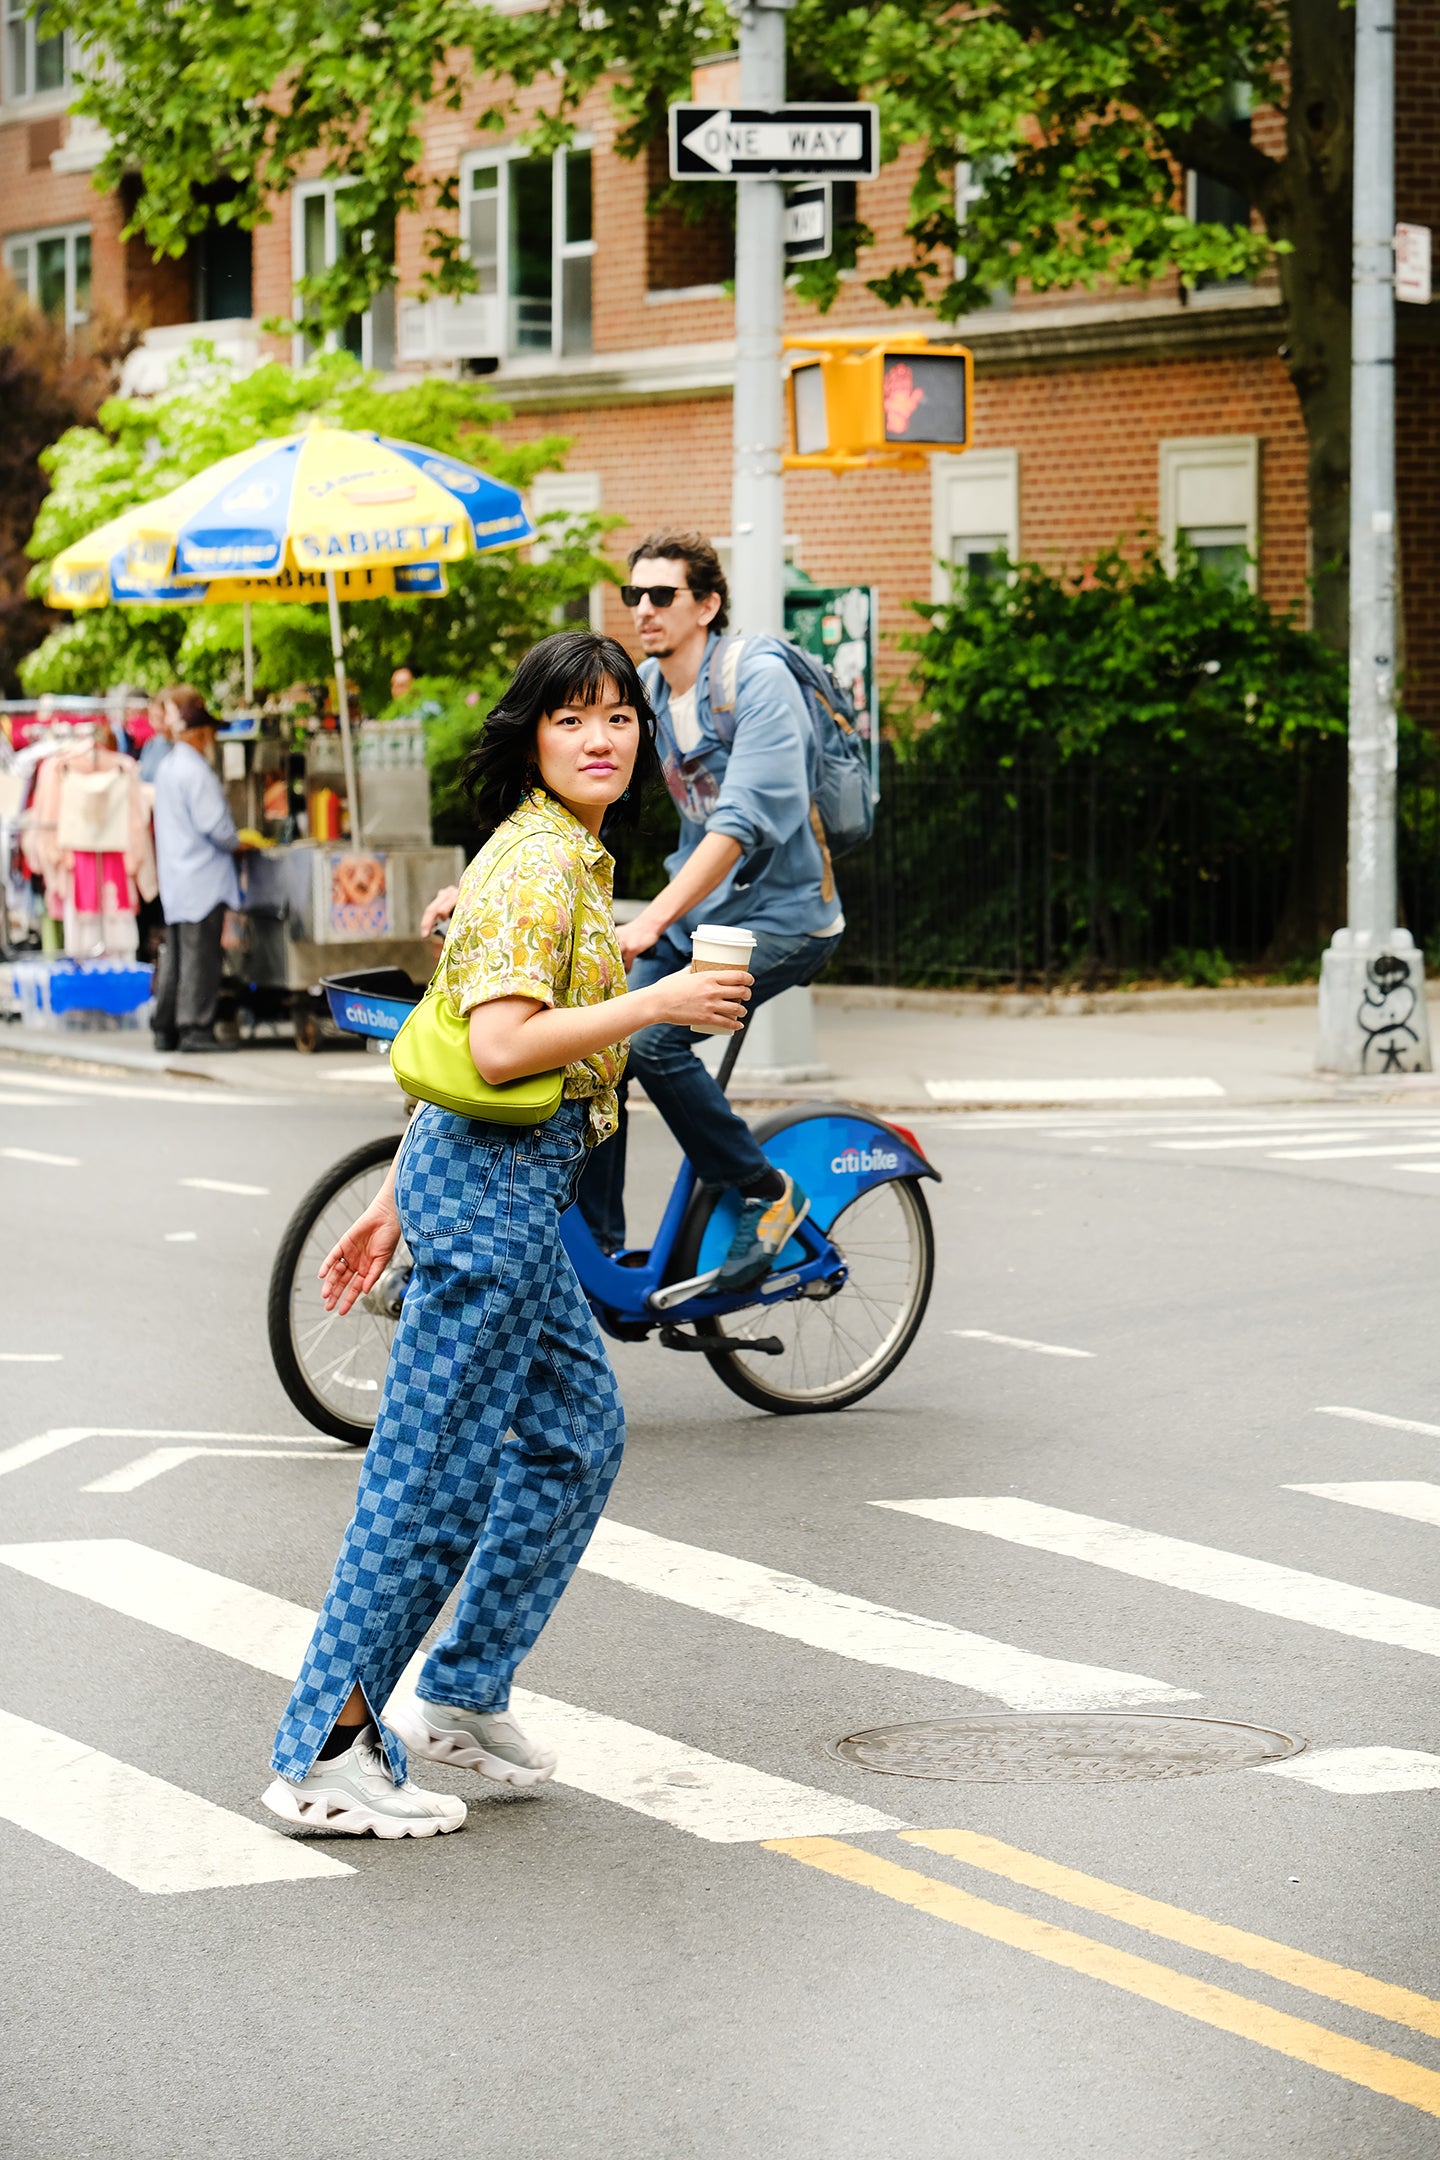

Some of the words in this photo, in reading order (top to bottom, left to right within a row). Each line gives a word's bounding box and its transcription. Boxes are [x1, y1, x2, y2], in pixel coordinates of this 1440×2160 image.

[704, 129, 760, 155] ONE
[788, 129, 847, 154] WAY
[303, 522, 455, 558] SABRETT
[345, 1004, 367, 1025] citi
[367, 1008, 400, 1031] bike
[831, 1149, 859, 1174] citi
[861, 1148, 898, 1172] bike
